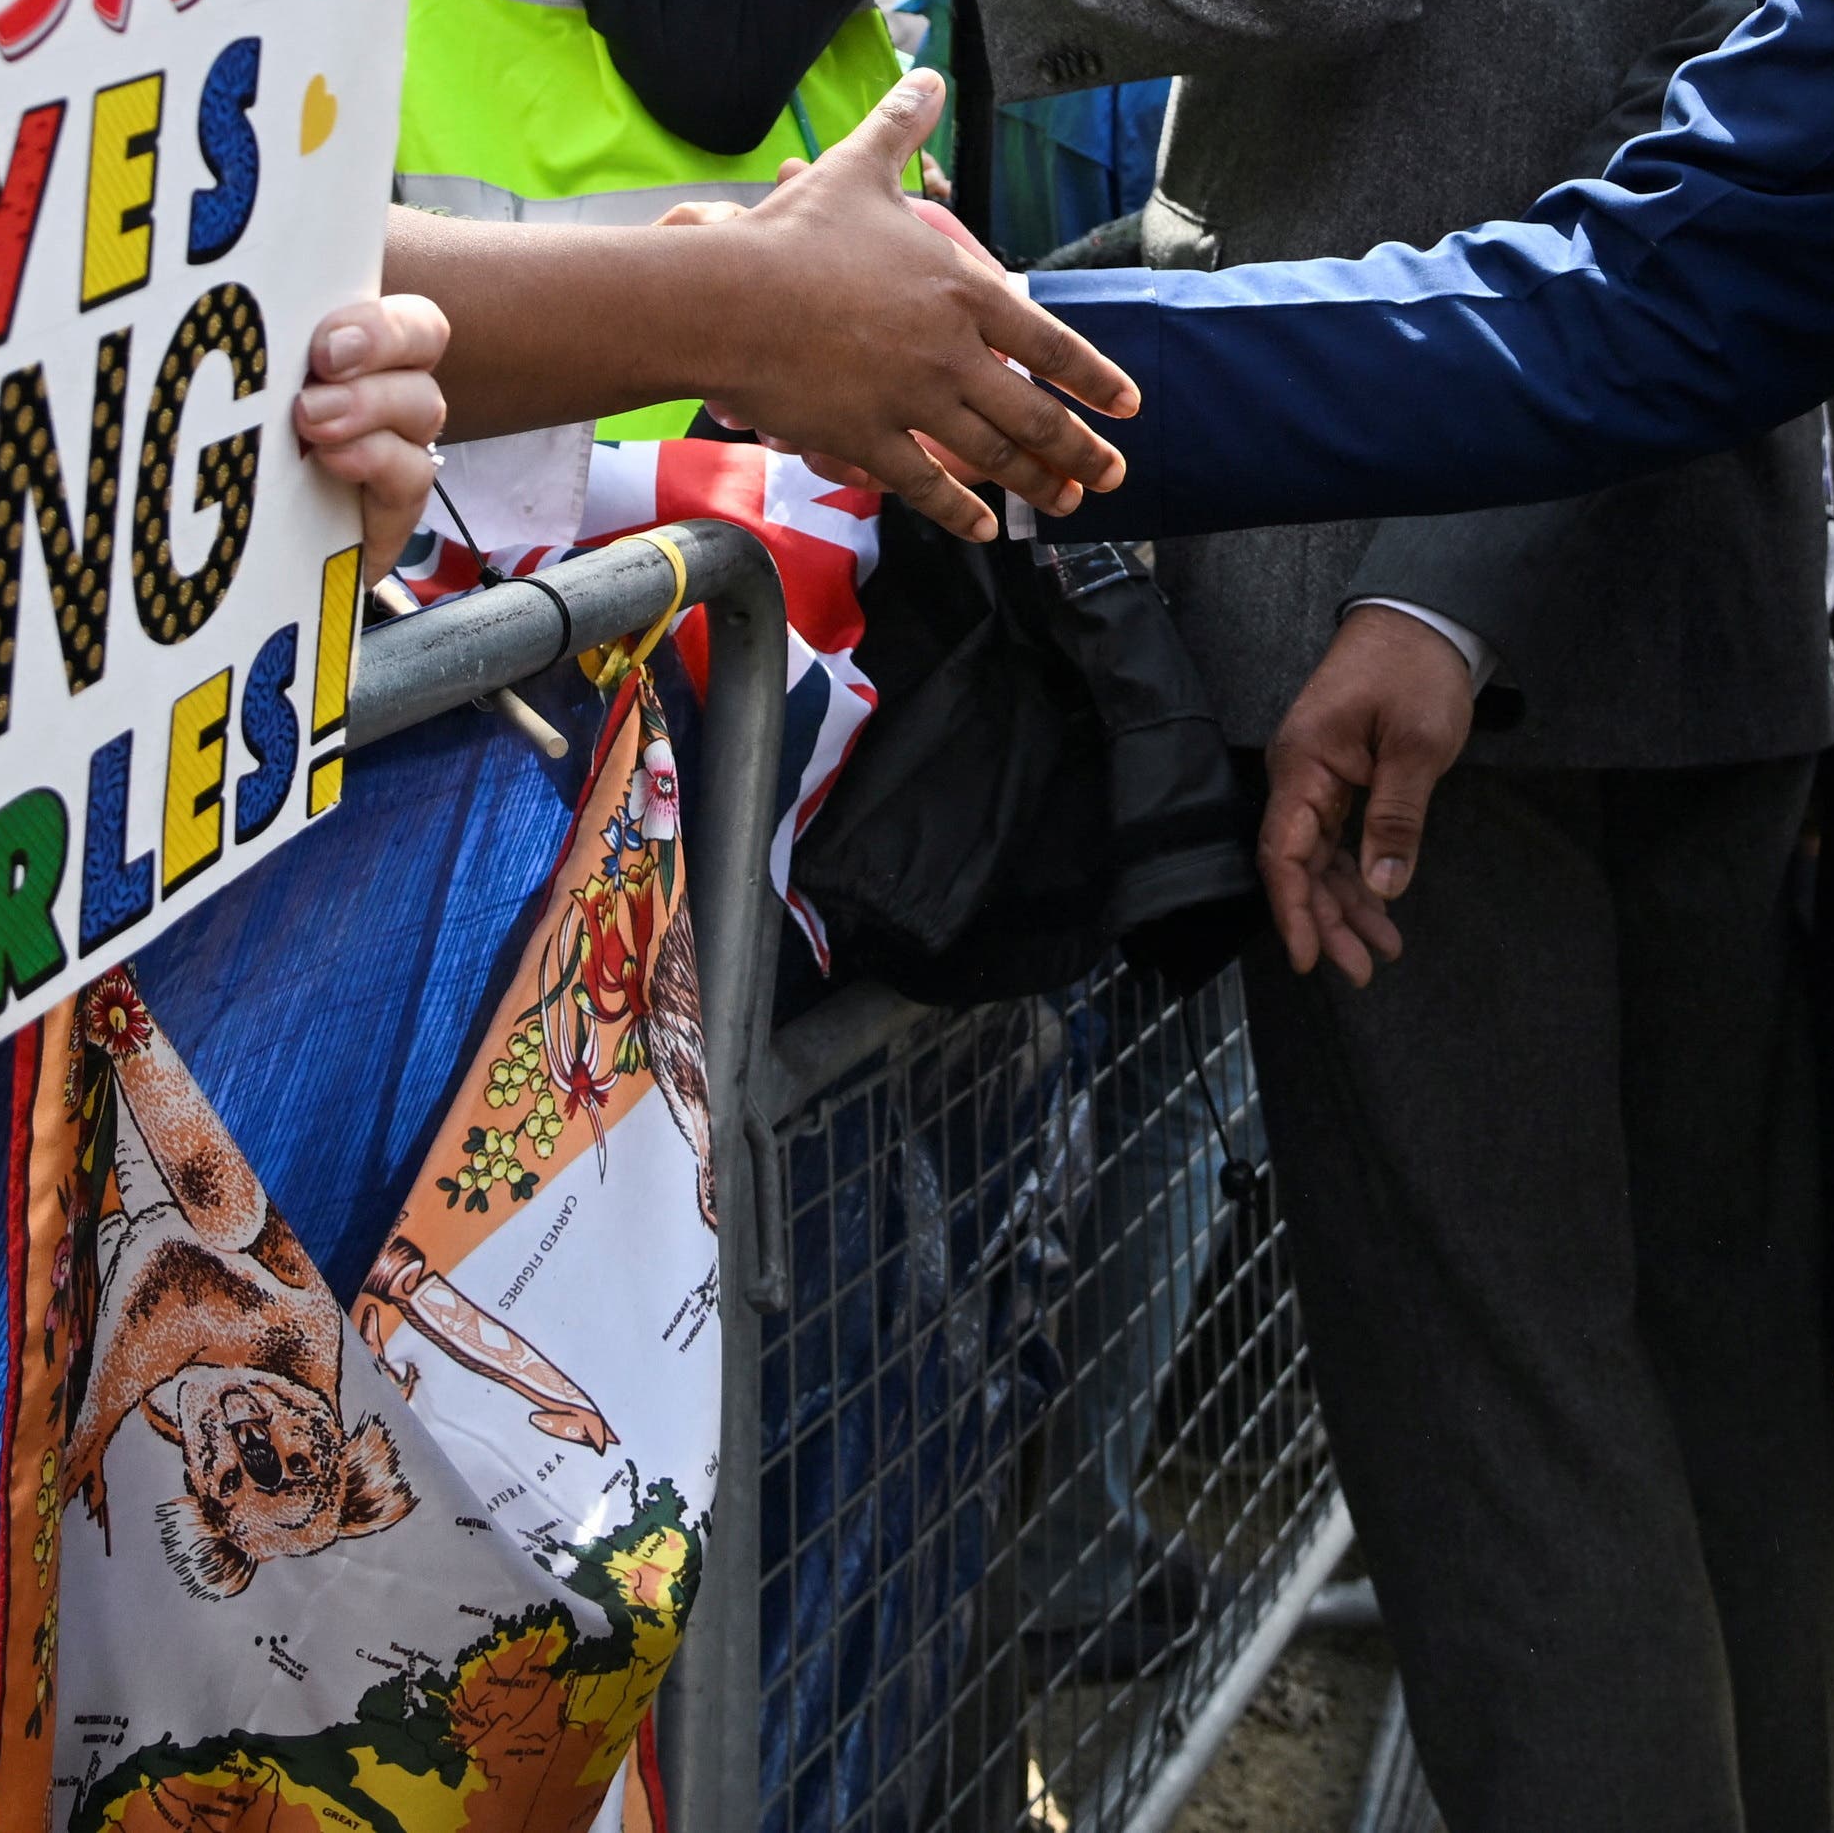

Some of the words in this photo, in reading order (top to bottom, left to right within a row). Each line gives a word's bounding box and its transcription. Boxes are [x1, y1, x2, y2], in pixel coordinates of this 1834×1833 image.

[539, 1194, 579, 1253] CARVED
[498, 1252, 544, 1311] FIGURES
[678, 1312, 708, 1354] THURSDAY
[536, 1452, 566, 1482] SEA
[455, 1516, 488, 1531] CARTIER
[642, 1532, 667, 1559] LAND
[267, 1654, 305, 1683] SHOALS
[270, 1644, 310, 1674] ROWLEY
[322, 1806, 360, 1830] GREAT
